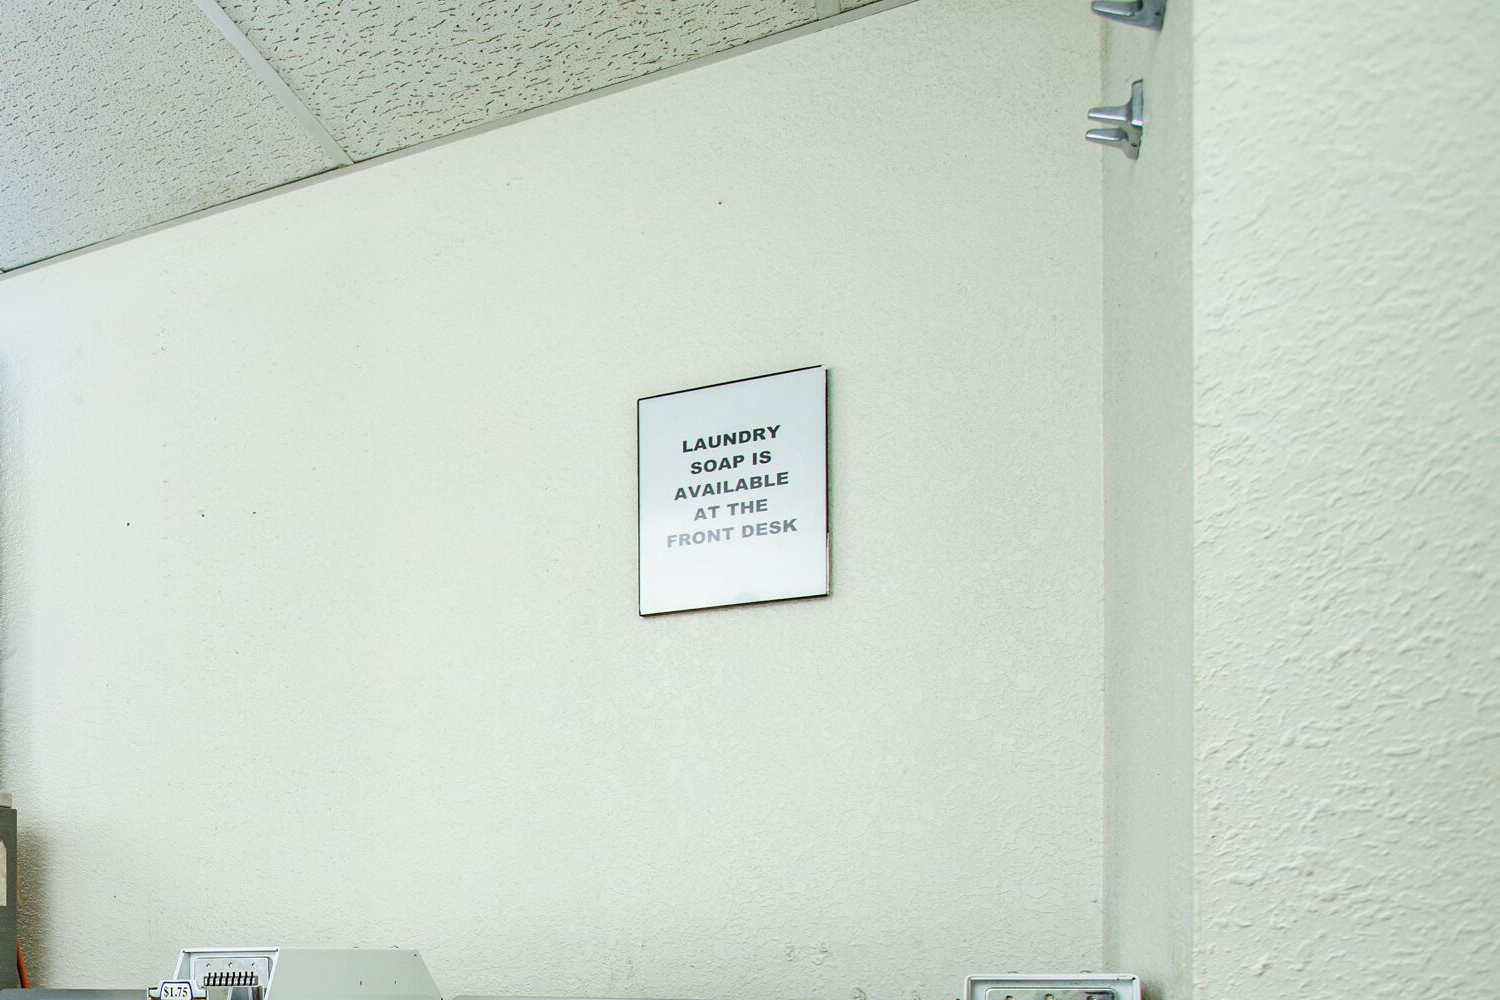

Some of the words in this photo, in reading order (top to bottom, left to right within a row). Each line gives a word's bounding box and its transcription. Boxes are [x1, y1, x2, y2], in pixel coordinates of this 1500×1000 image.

[682, 425, 780, 453] LAUNDRY
[690, 455, 745, 475] SOAP
[752, 450, 772, 466] IS
[674, 472, 789, 501] AVAILABLE
[693, 505, 720, 521] AT
[727, 499, 768, 516] THE
[667, 527, 735, 548] FRONT
[741, 518, 798, 538] DESK
[163, 987, 188, 998] $1.75
